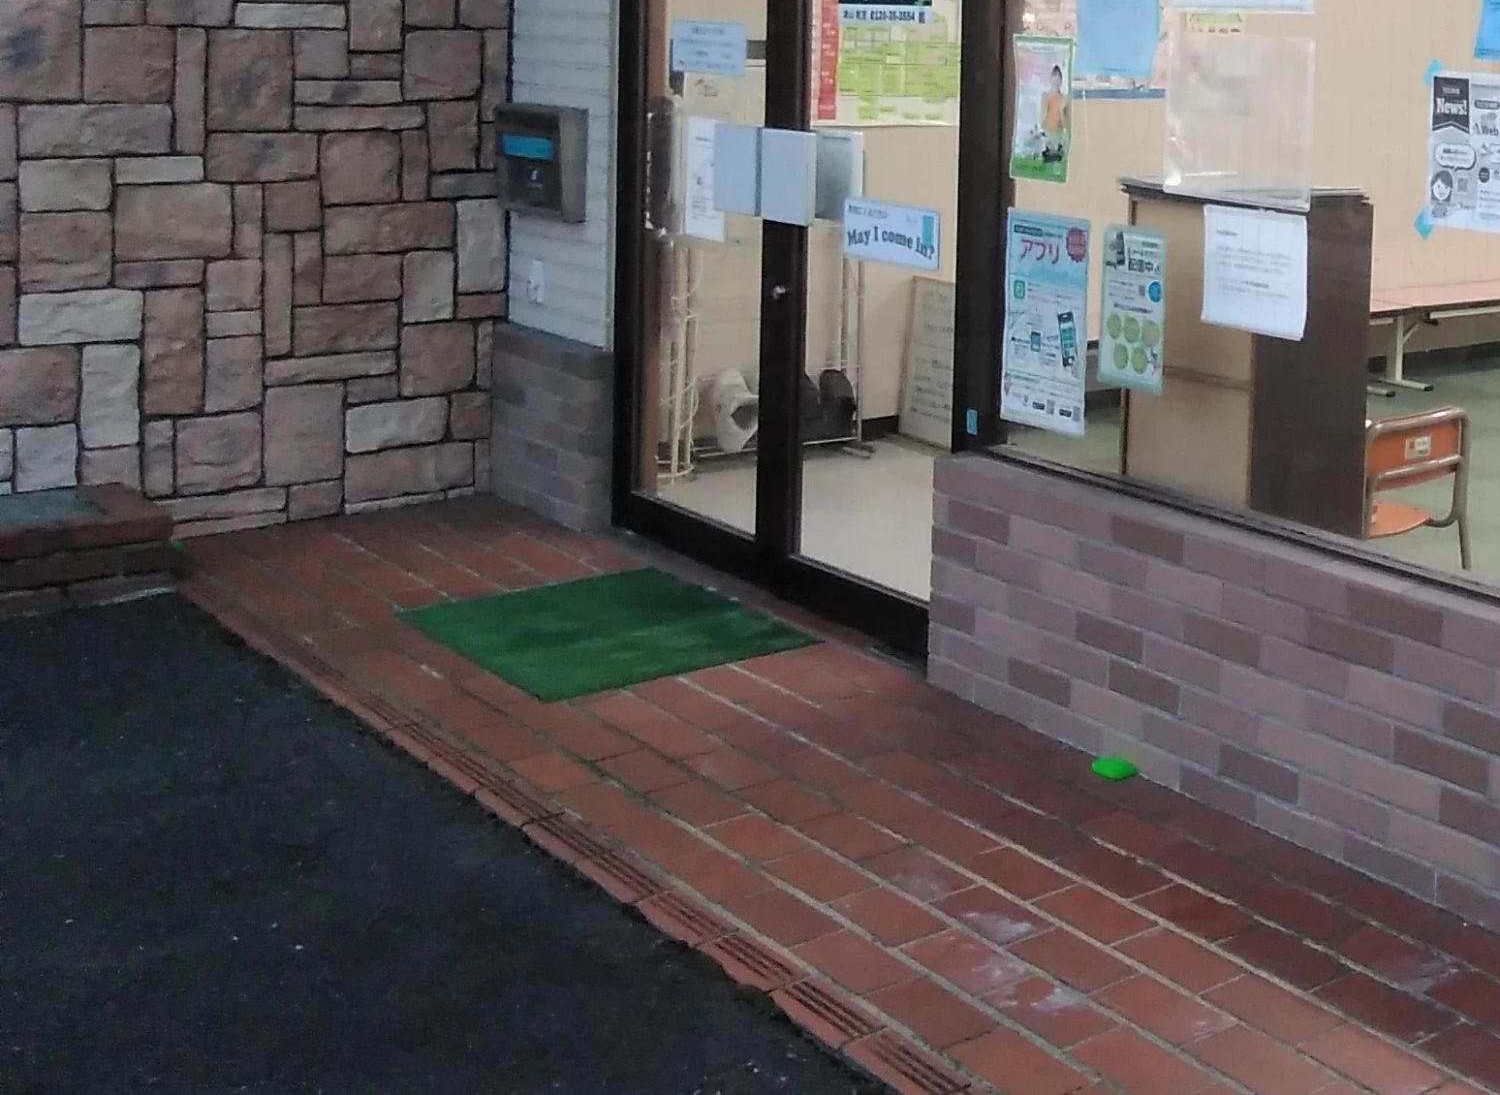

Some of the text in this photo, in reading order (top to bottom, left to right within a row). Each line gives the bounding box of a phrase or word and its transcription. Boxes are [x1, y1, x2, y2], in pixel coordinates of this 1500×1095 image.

[1436, 97, 1467, 115] News!
[847, 225, 935, 260] May I come in?
[1020, 239, 1060, 264] アプリ
